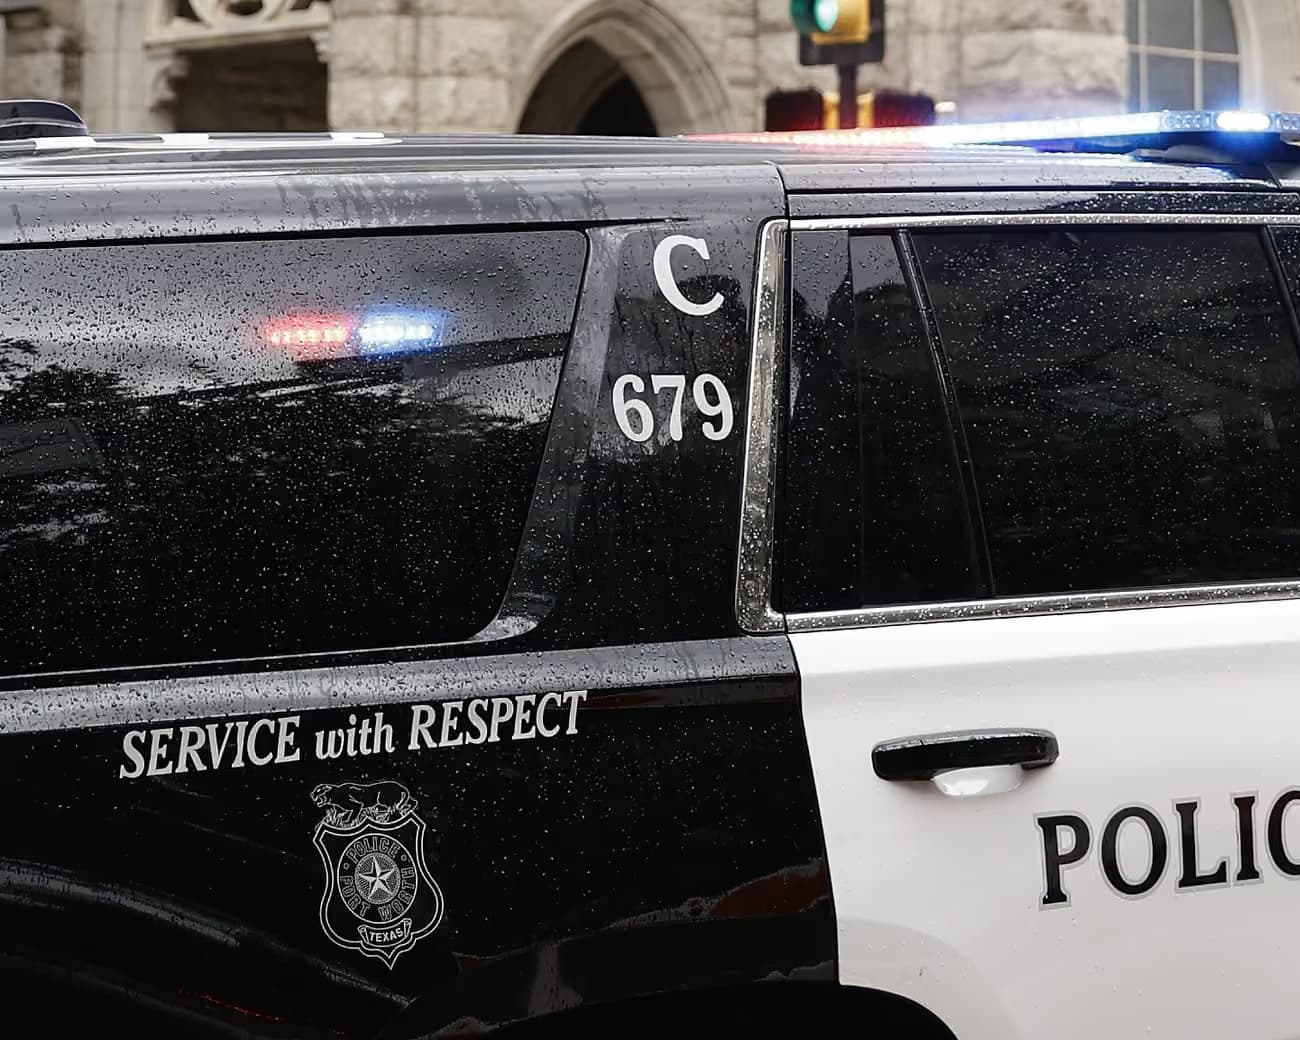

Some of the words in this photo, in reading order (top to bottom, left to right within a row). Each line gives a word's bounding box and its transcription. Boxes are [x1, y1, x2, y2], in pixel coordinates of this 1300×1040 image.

[653, 234, 725, 316] C
[612, 373, 734, 442] 679
[119, 716, 300, 779] SERVICE
[315, 713, 395, 760] with
[407, 690, 588, 750] RESPECT
[346, 837, 401, 863] POLICE
[340, 875, 371, 918] FORT
[377, 866, 415, 921] WORTH
[369, 927, 405, 943] TEXAS
